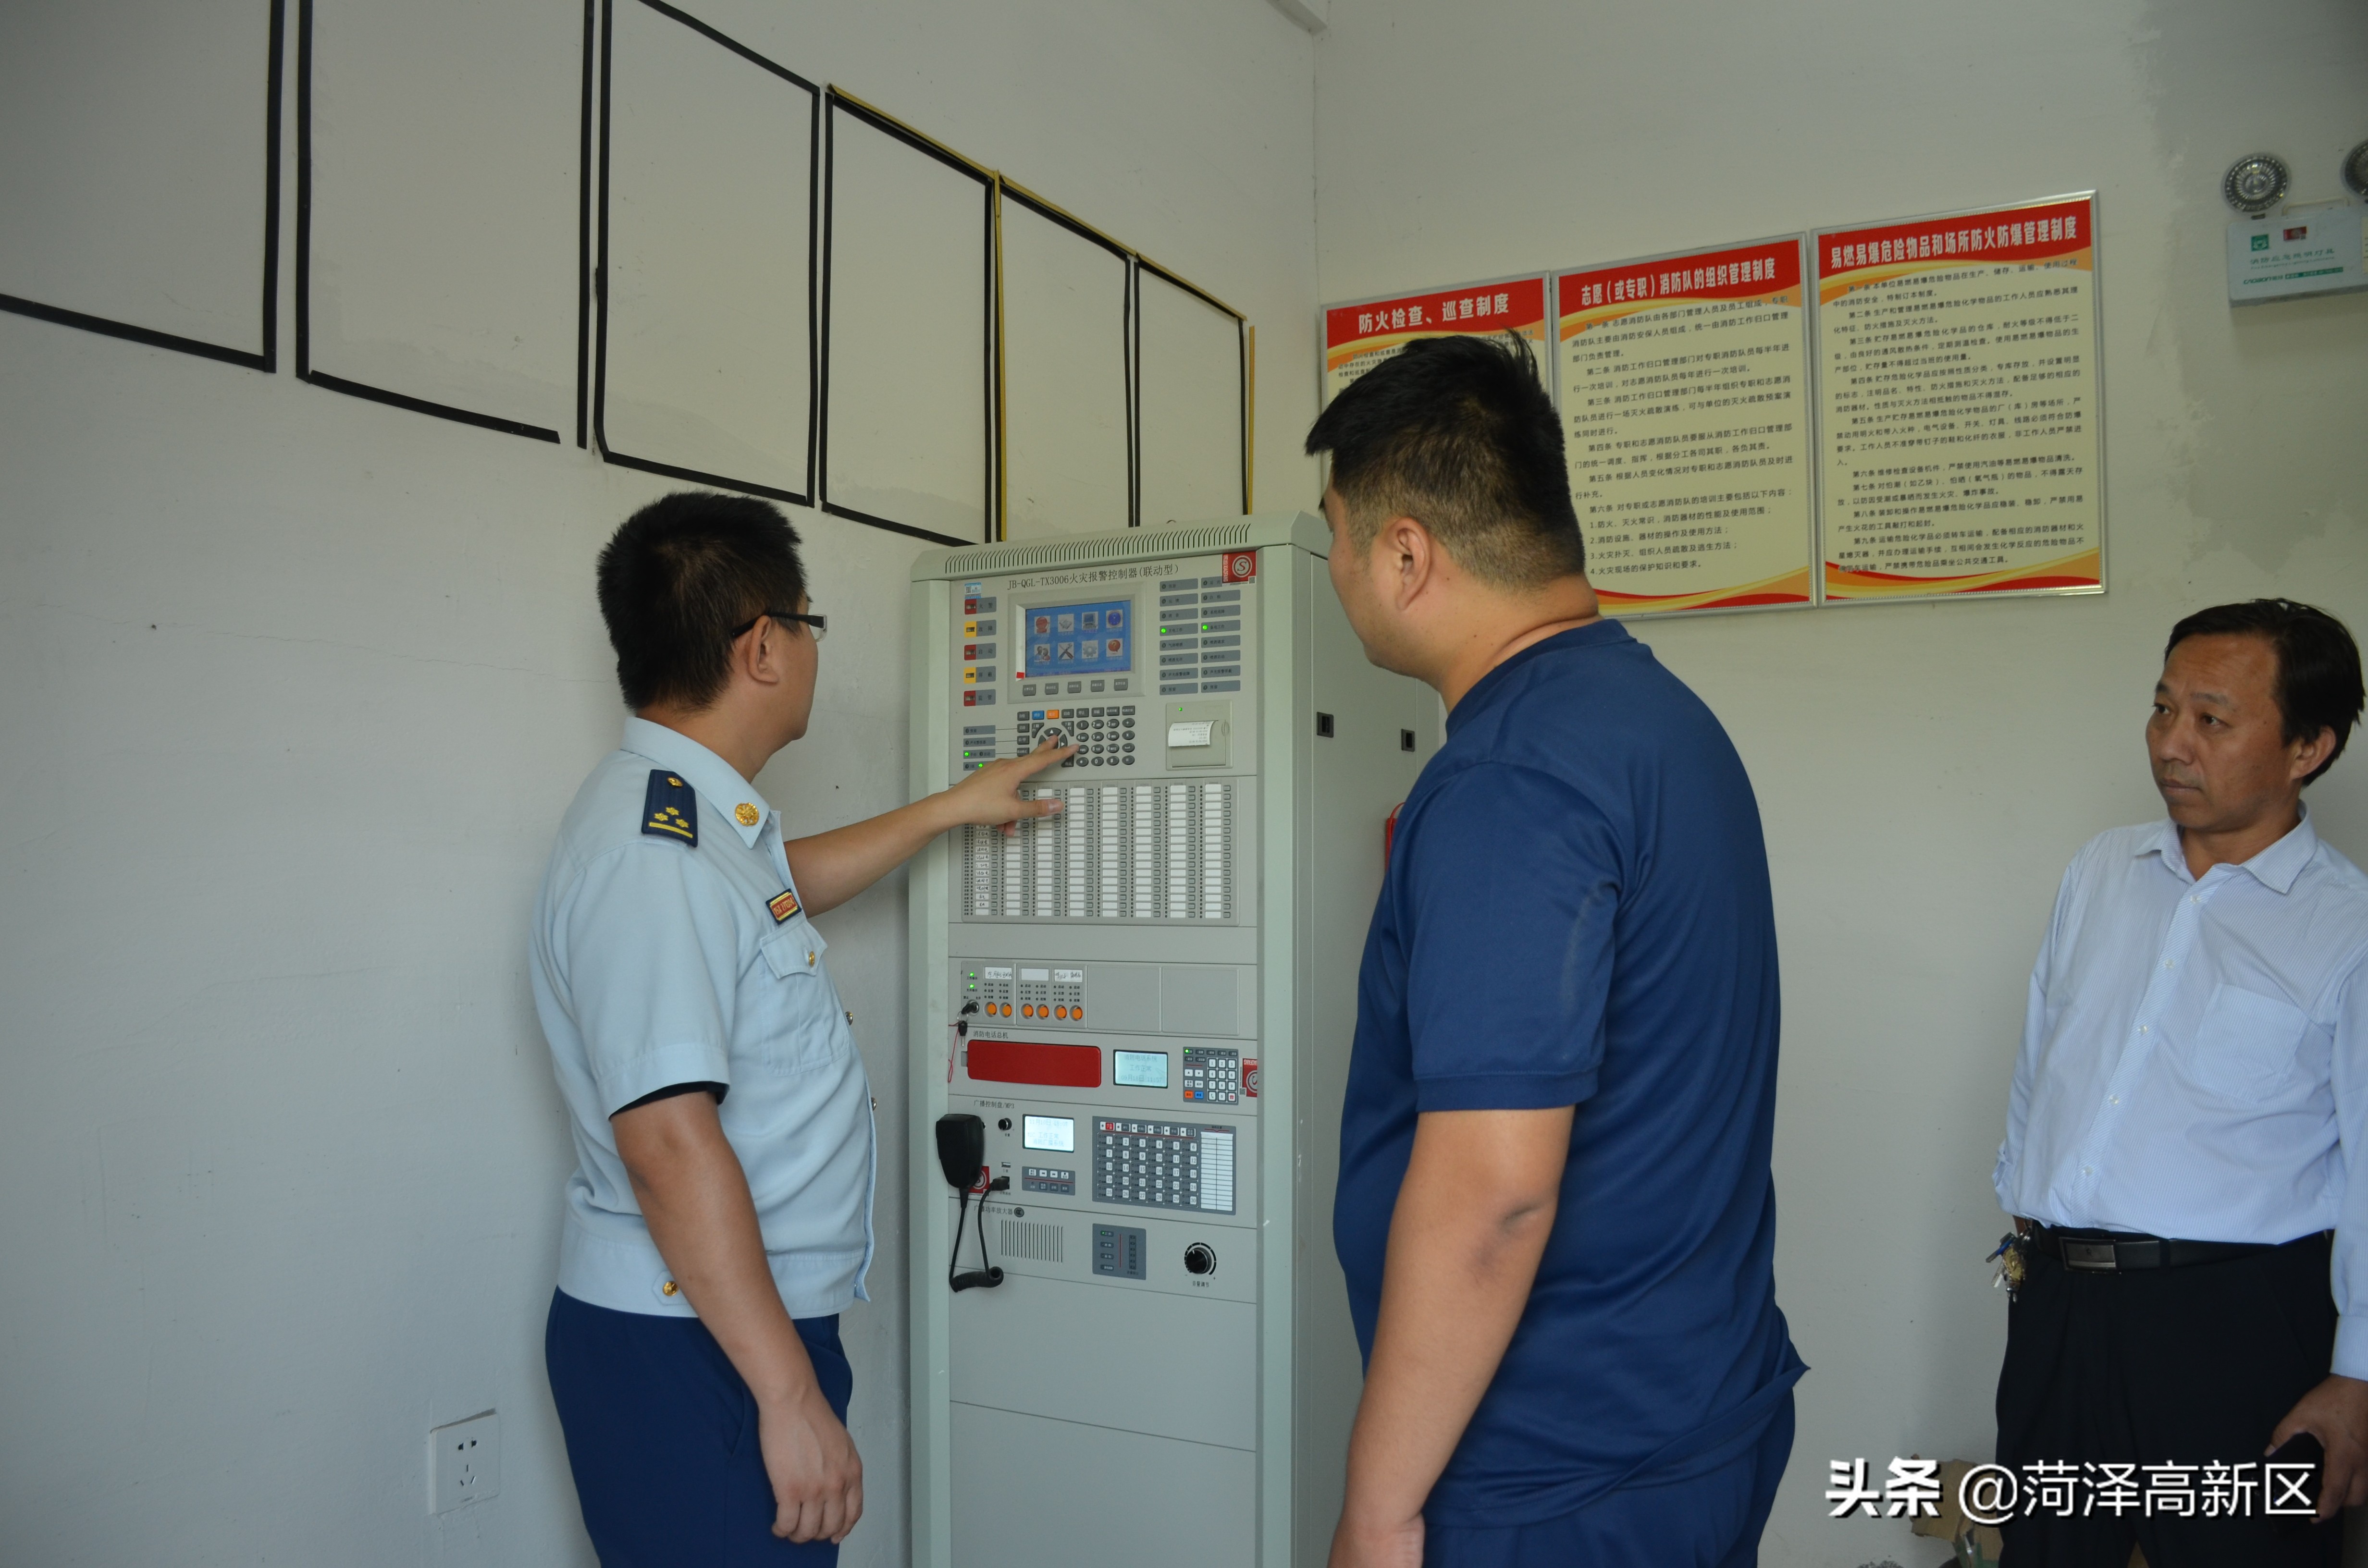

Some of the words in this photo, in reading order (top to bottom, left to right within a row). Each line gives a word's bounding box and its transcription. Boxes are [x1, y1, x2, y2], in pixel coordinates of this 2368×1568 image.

[1831, 216, 2077, 269] 易燃易爆危险物品和场所防火防爆管理制度
[1581, 257, 1776, 306] 志愿（或专职）消防队的组织管理制度
[1358, 293, 1509, 334] 防火检查、巡查制度
[1587, 321, 1609, 330] 第一条
[1587, 366, 1610, 376] 第二条
[1588, 398, 1611, 406] 第三条
[1589, 443, 1611, 452] 第四条
[1589, 474, 1612, 483] 第五条
[1590, 505, 1613, 514] 第六条
[973, 1030, 1008, 1039] 消防电话总机
